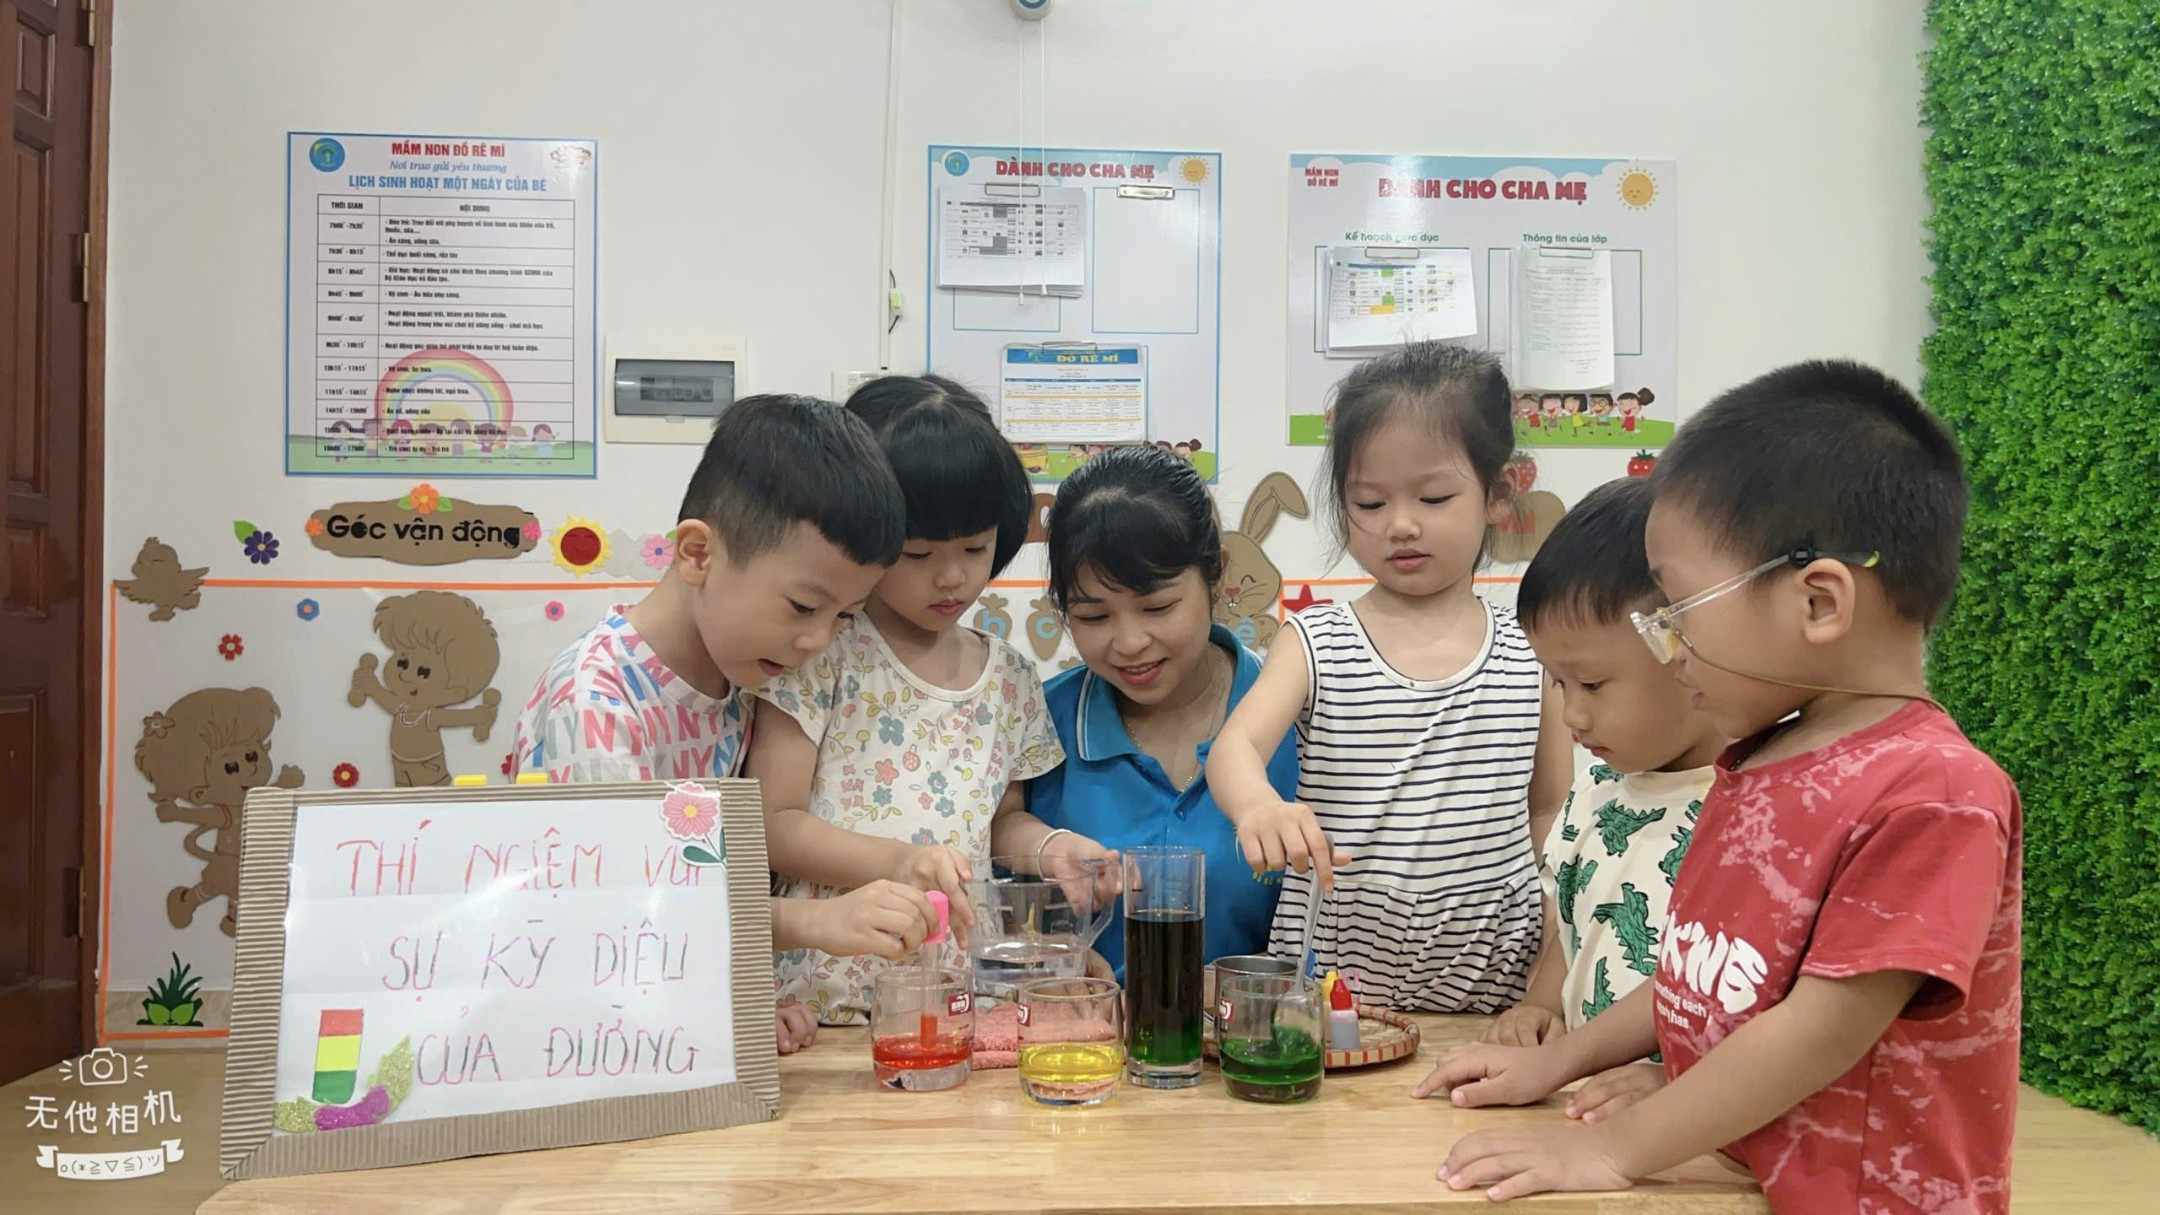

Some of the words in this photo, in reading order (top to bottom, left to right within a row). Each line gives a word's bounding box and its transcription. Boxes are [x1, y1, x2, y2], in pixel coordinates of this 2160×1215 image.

[425, 144, 450, 156] NON
[410, 162, 430, 170] trao
[996, 156, 1043, 177] DÀNH
[1048, 162, 1086, 178] CHO
[1090, 164, 1126, 180] CHA
[1130, 164, 1155, 183] MẸ
[348, 175, 376, 190] LỊCH
[378, 176, 407, 189] SINH
[410, 176, 440, 192] HOẠT
[443, 176, 468, 192] MỘT
[471, 176, 503, 190] NGÀY
[506, 175, 529, 192] CỦA
[532, 178, 547, 192] BÉ
[1446, 179, 1497, 200] CHO
[1502, 180, 1550, 200] CHA
[1555, 182, 1587, 206] MẸ
[326, 514, 386, 540] Góc
[393, 517, 444, 546] vận
[452, 520, 520, 549] động
[336, 819, 432, 896] THÍ
[382, 930, 444, 1003] SỰ
[1682, 998, 1708, 1018] each
[417, 1005, 502, 1087] CỦA
